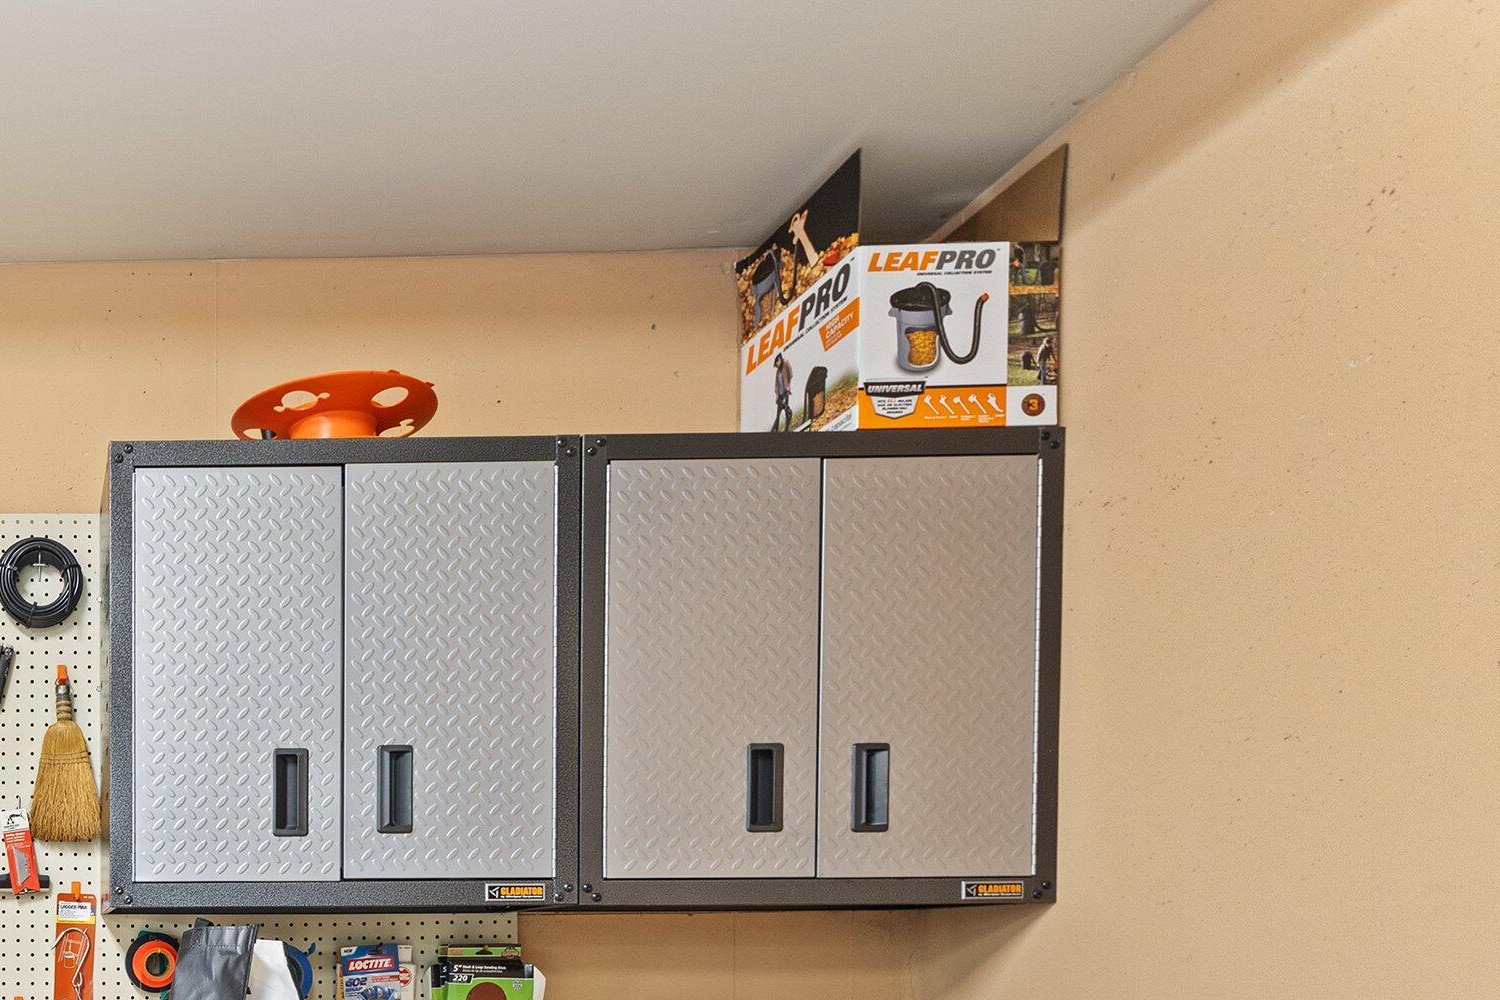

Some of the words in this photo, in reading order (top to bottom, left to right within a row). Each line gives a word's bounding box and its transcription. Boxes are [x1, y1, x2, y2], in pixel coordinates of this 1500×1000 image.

[867, 249, 997, 273] LEAFPRO
[746, 262, 851, 376] LEAFPRO
[867, 383, 924, 394] UNIVERSAL
[500, 886, 543, 896] GLADIATOR
[978, 884, 1022, 893] GLADIATOR
[452, 974, 468, 982] 220
